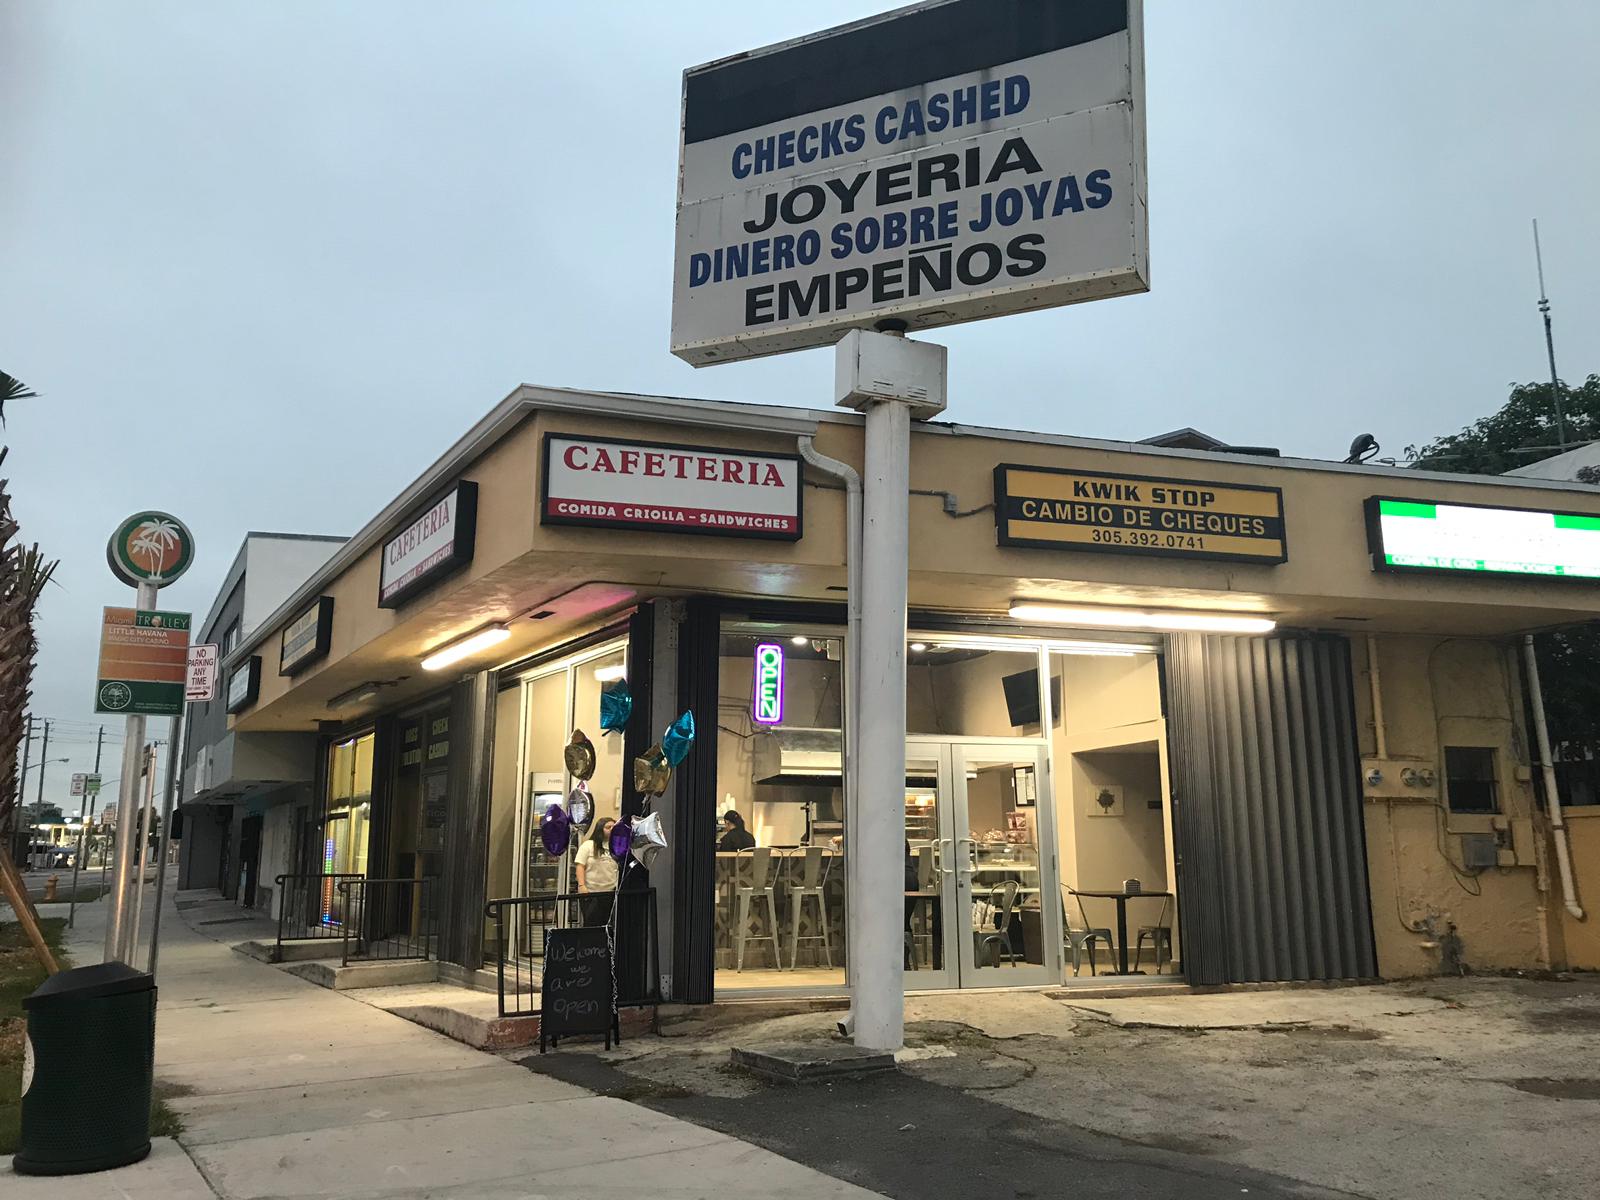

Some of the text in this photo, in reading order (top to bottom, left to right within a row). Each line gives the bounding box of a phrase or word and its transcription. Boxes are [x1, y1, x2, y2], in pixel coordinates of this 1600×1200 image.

[732, 75, 1031, 179] CHECKS CASHED
[743, 137, 1043, 234] JOYERIA
[689, 169, 1113, 288] DINERO SOBRE JOYAS
[745, 234, 1047, 326] EMPEÑOS
[563, 445, 785, 487] CAFETERIA
[1073, 480, 1215, 507] KWIK STOP
[558, 502, 617, 518] COMIDA
[623, 507, 685, 522] CRIOLLA
[699, 513, 789, 530] SANDWICHES
[1022, 500, 1265, 536] CAMBIO DE CHEQUES
[390, 501, 450, 566] CAFETERIA
[1092, 529, 1204, 550] 305.392.0741
[108, 627, 168, 638] LITTLE HAVANA
[188, 658, 214, 667] PARKING
[196, 649, 206, 658] NO
[192, 676, 207, 686] TIME
[193, 667, 207, 676] ANY
[761, 648, 779, 718] OPEN
